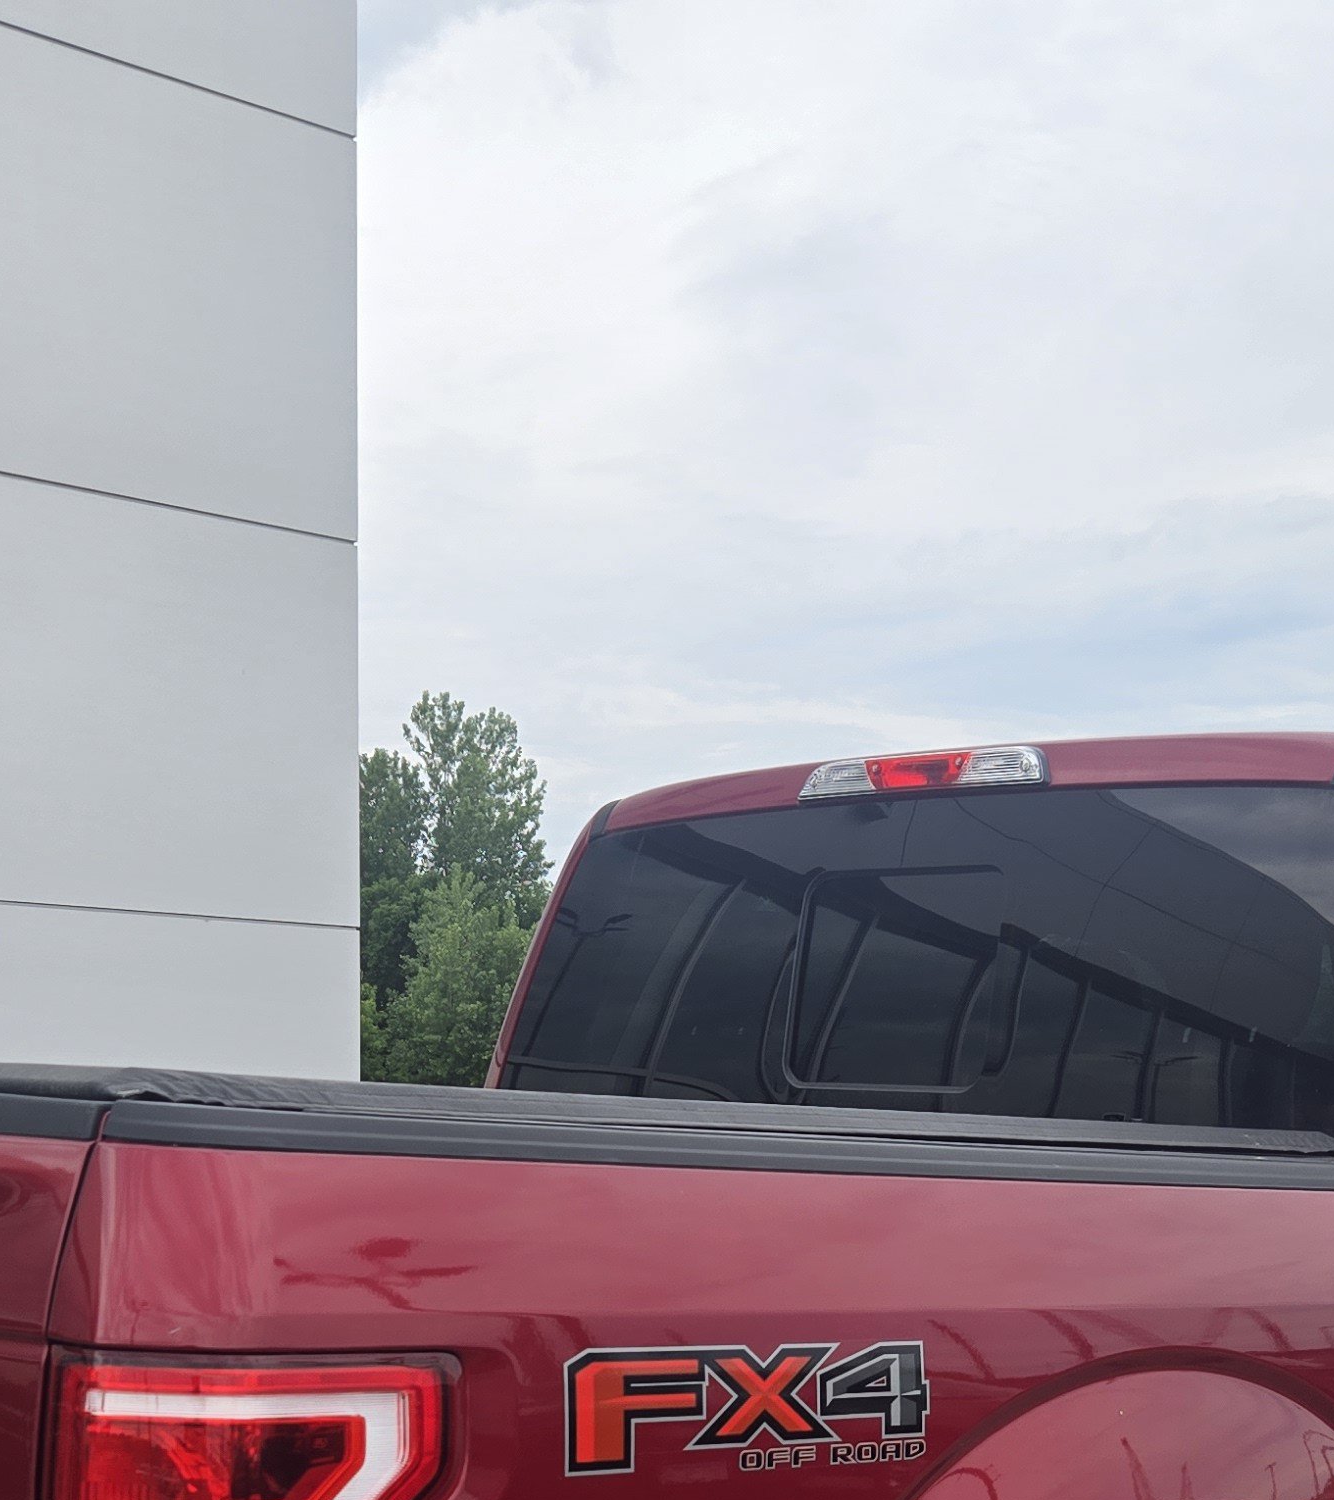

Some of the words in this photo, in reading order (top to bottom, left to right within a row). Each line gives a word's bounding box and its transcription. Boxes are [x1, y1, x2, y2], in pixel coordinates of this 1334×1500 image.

[564, 1340, 931, 1477] FX4
[739, 1446, 816, 1471] OFF
[830, 1439, 926, 1465] ROAD
